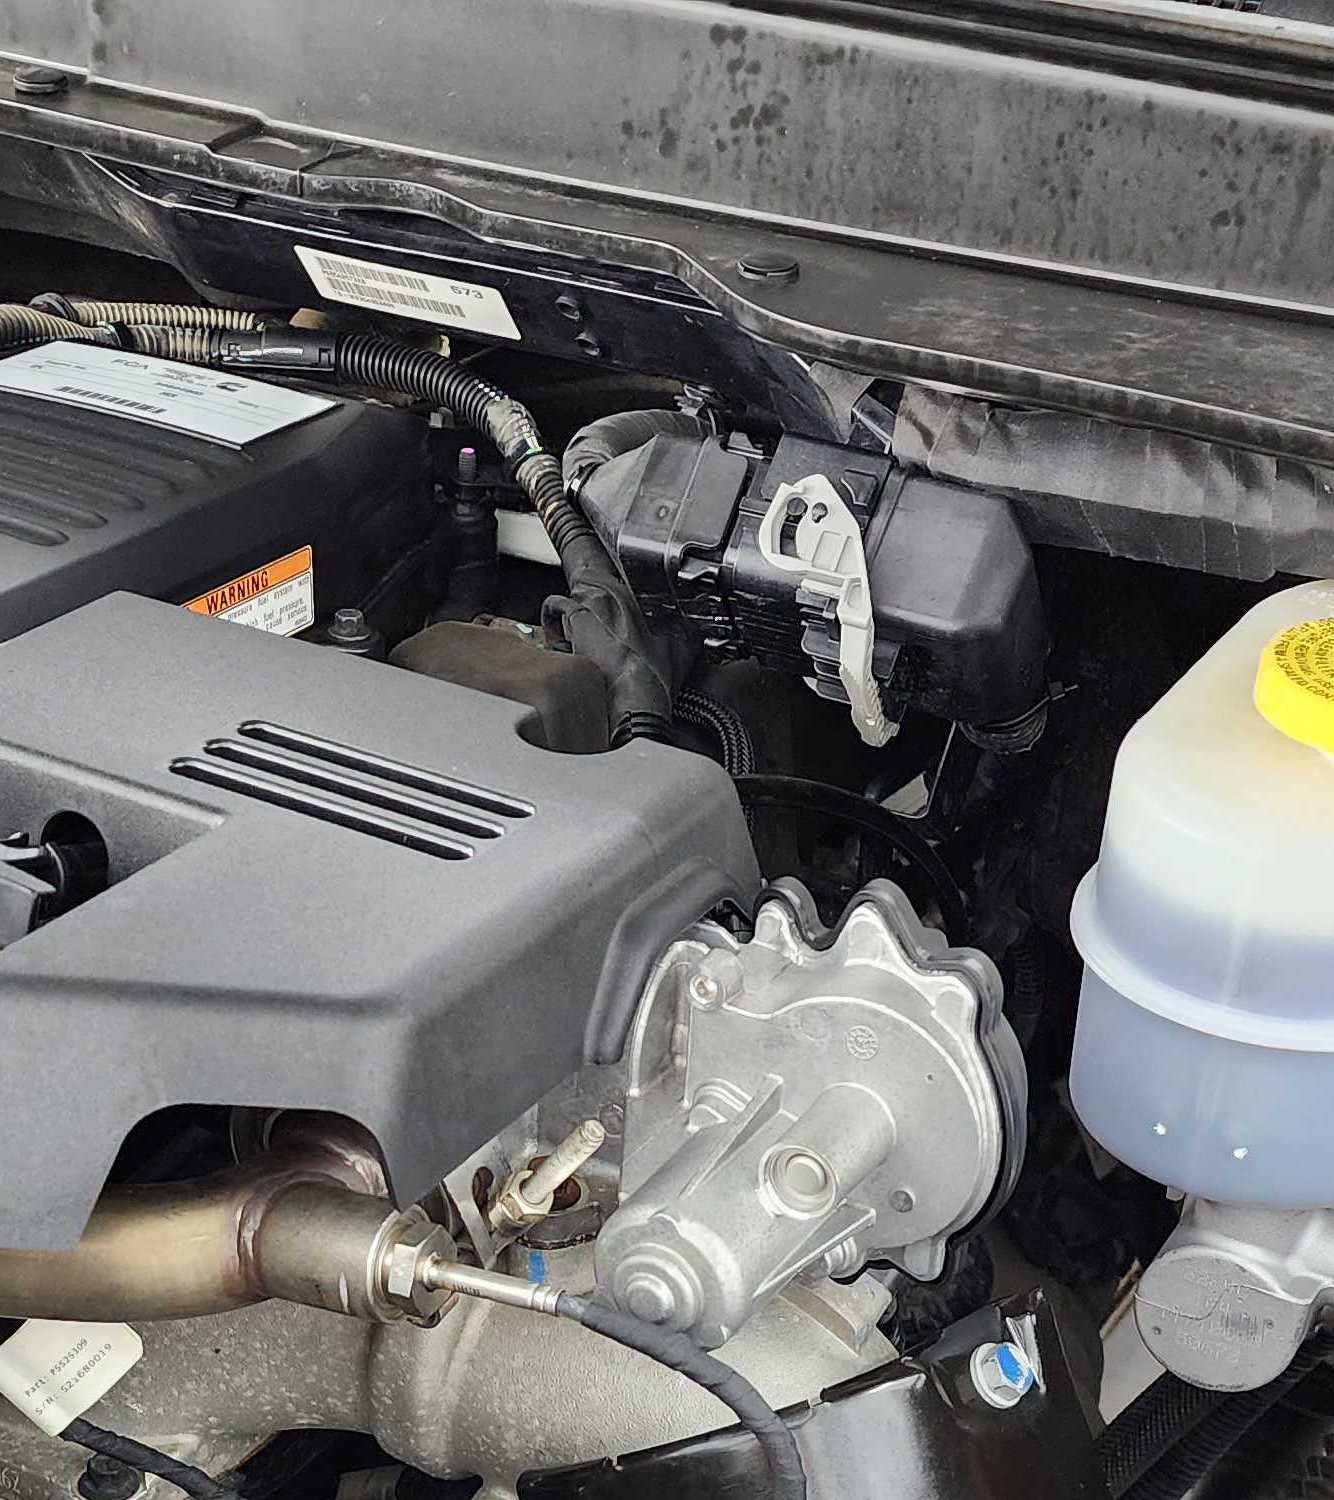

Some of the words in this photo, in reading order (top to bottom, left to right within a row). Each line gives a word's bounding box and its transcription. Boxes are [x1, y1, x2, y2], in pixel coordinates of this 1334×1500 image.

[450, 285, 484, 300] 573
[207, 571, 269, 615] WARNING
[24, 1374, 51, 1398] Part:
[34, 1392, 60, 1416] S/N:
